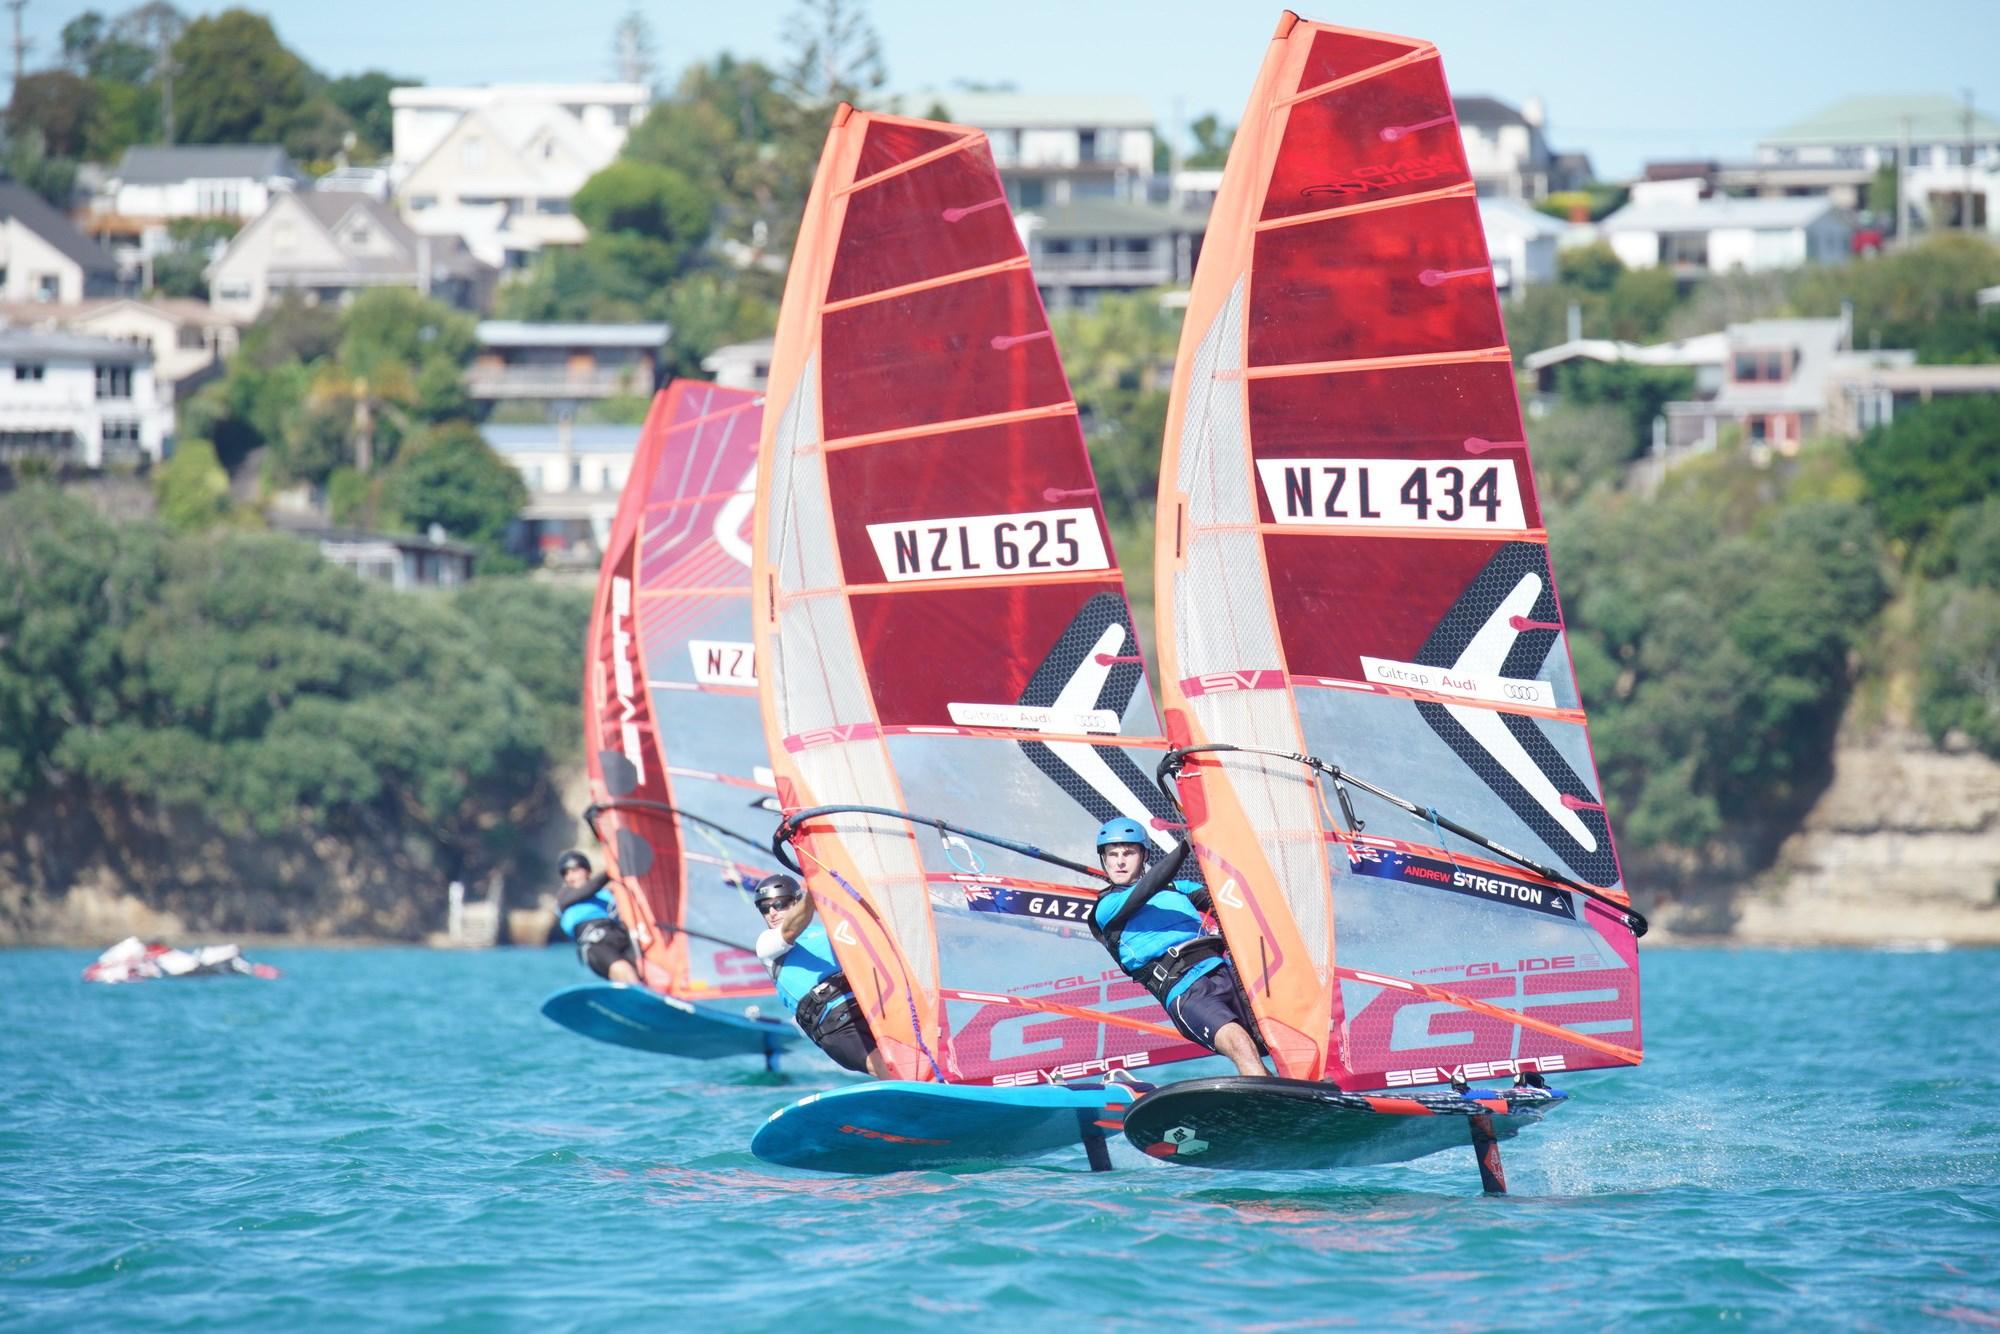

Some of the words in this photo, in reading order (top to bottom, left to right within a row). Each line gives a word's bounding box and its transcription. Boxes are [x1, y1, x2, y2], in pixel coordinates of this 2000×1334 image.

[1284, 466, 1381, 518] NZL
[1400, 467, 1502, 522] 434
[893, 526, 981, 575] NZL
[993, 518, 1080, 570] 625
[1377, 665, 1429, 686] Giltrap
[1441, 675, 1477, 692] Audi
[1403, 865, 1452, 883] ANDREW
[1453, 871, 1543, 905] STRETTON
[992, 1051, 1150, 1088] SEVERNE
[1384, 1054, 1567, 1087] SEVERNE
